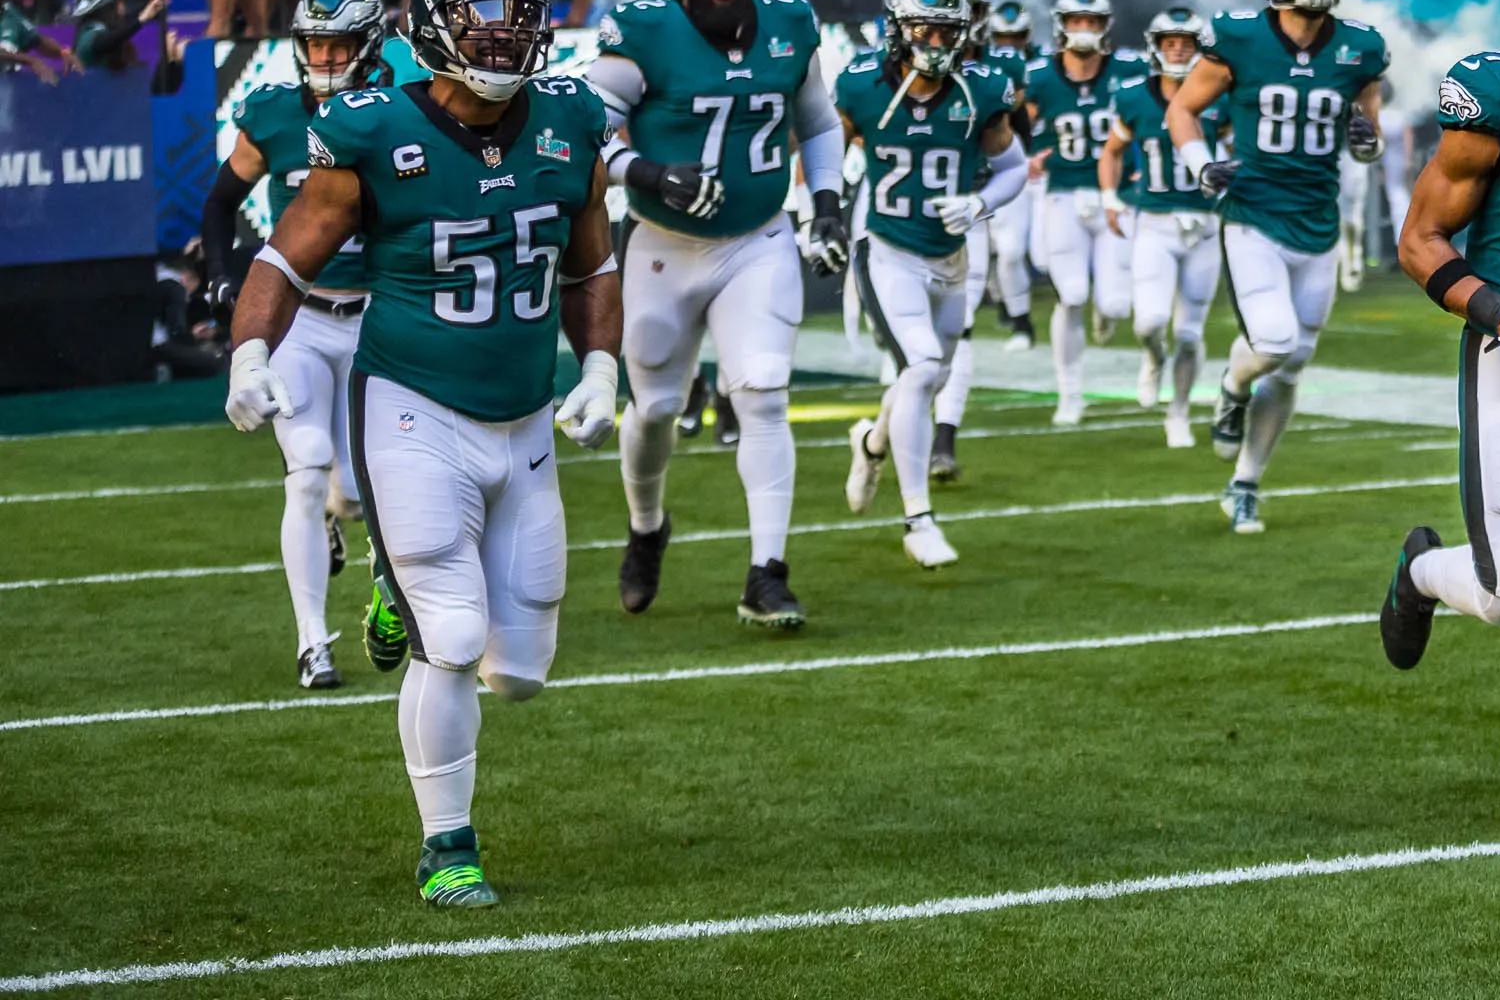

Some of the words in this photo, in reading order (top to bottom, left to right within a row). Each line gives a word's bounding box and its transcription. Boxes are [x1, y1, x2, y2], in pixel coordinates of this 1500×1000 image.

[693, 92, 785, 178] 72
[1257, 83, 1343, 156] 88
[62, 144, 142, 184] LVII
[392, 143, 425, 172] C
[874, 145, 961, 219] 29
[431, 202, 561, 326] 55
